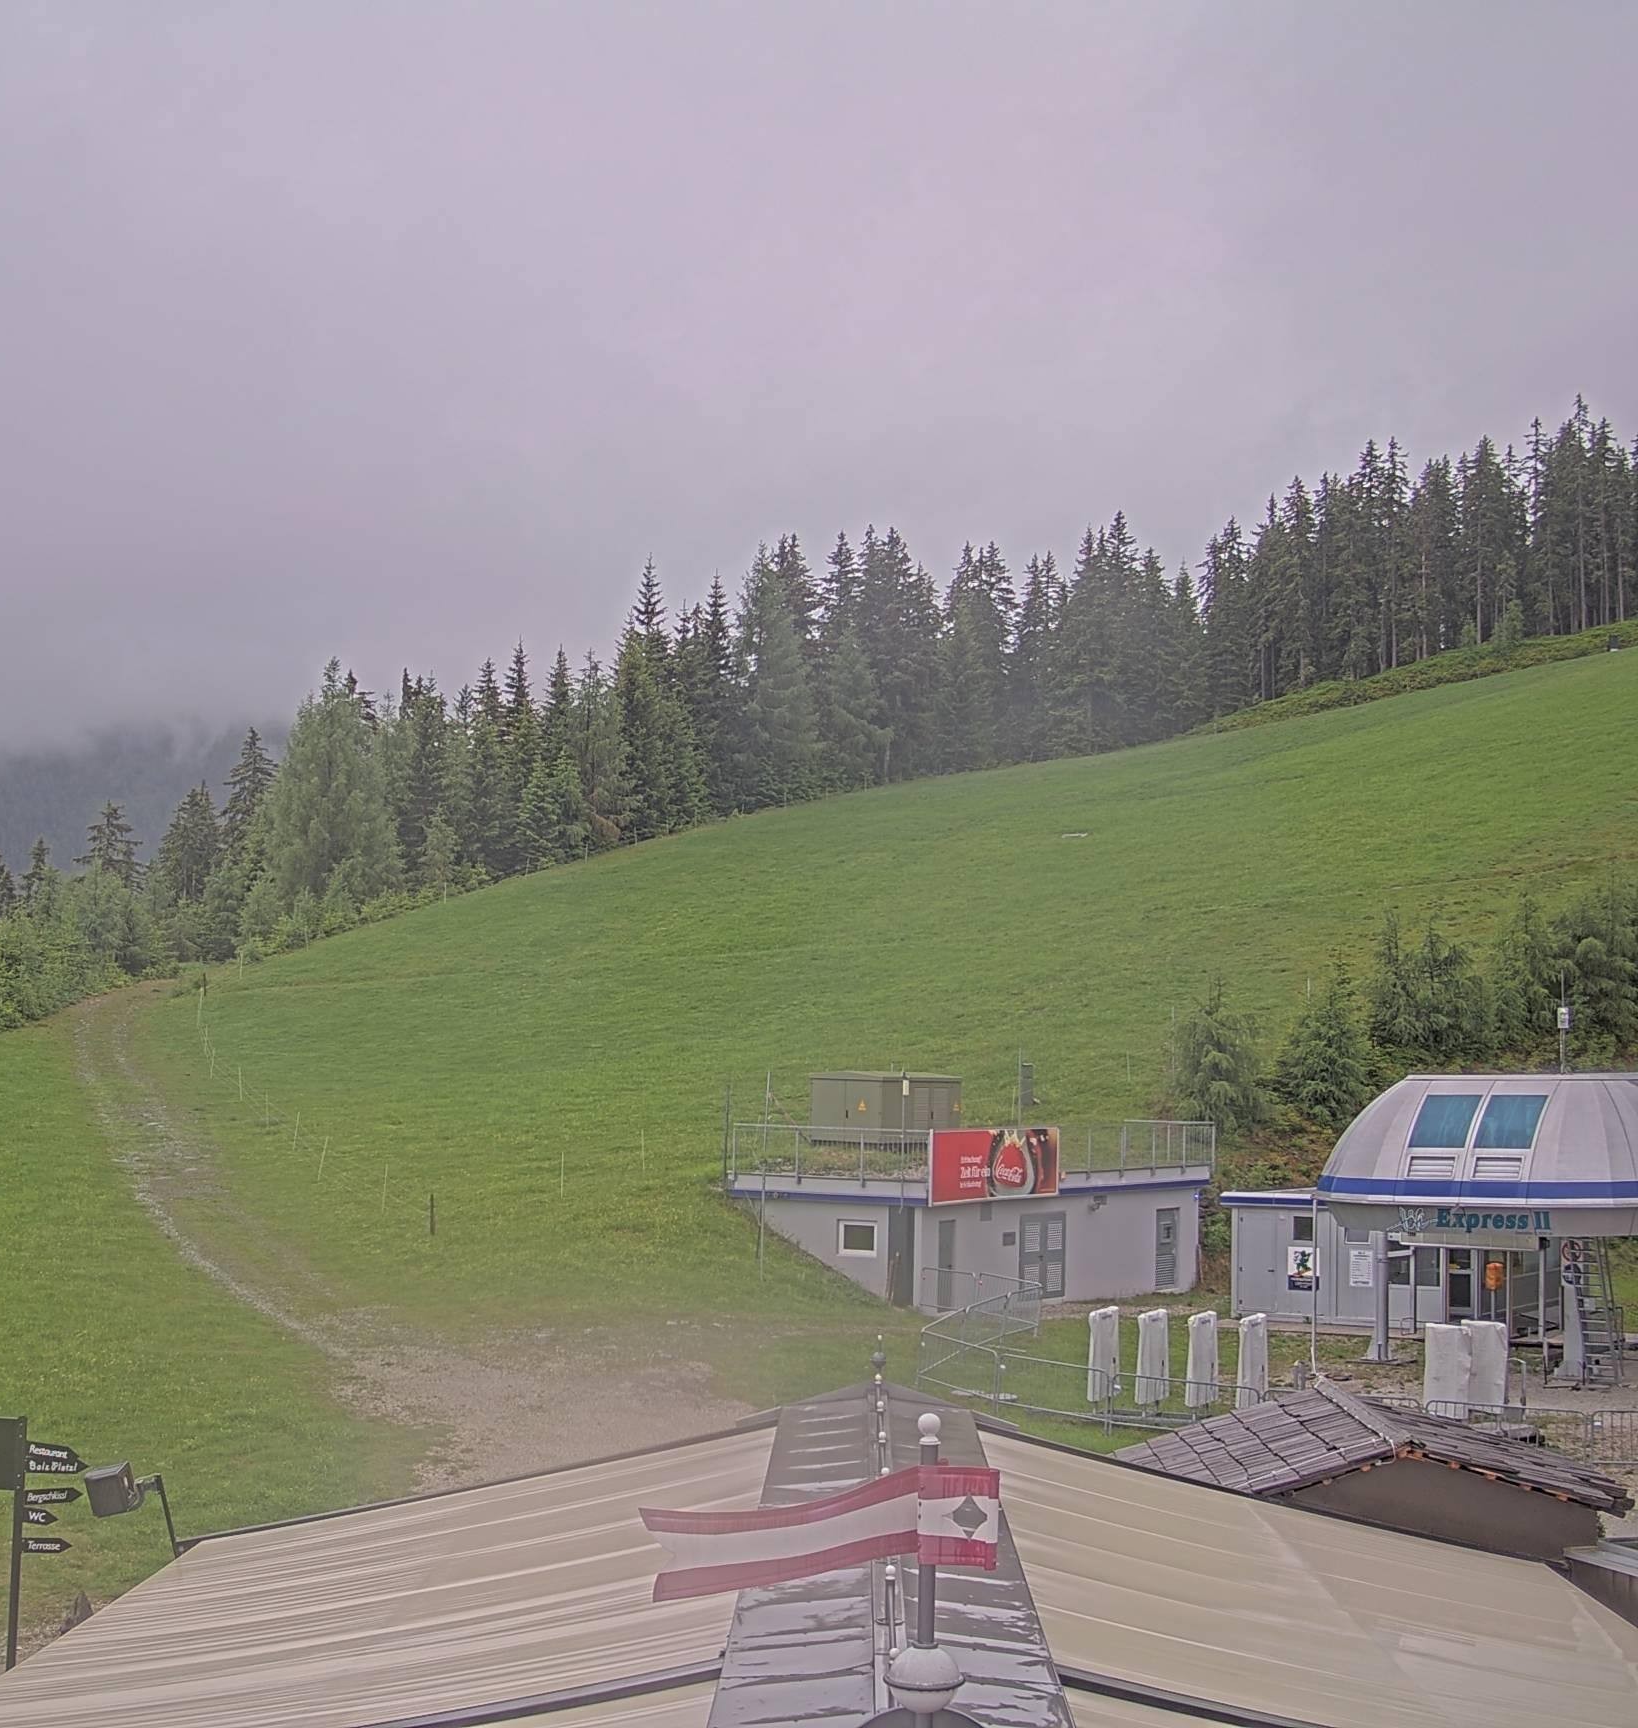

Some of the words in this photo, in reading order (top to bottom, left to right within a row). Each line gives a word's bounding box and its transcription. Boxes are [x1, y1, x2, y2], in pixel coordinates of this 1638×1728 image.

[1436, 1208, 1529, 1233] Express
[29, 1444, 68, 1459] Restaurant
[28, 1510, 47, 1522] WC
[28, 1540, 62, 1551] Terrasse
